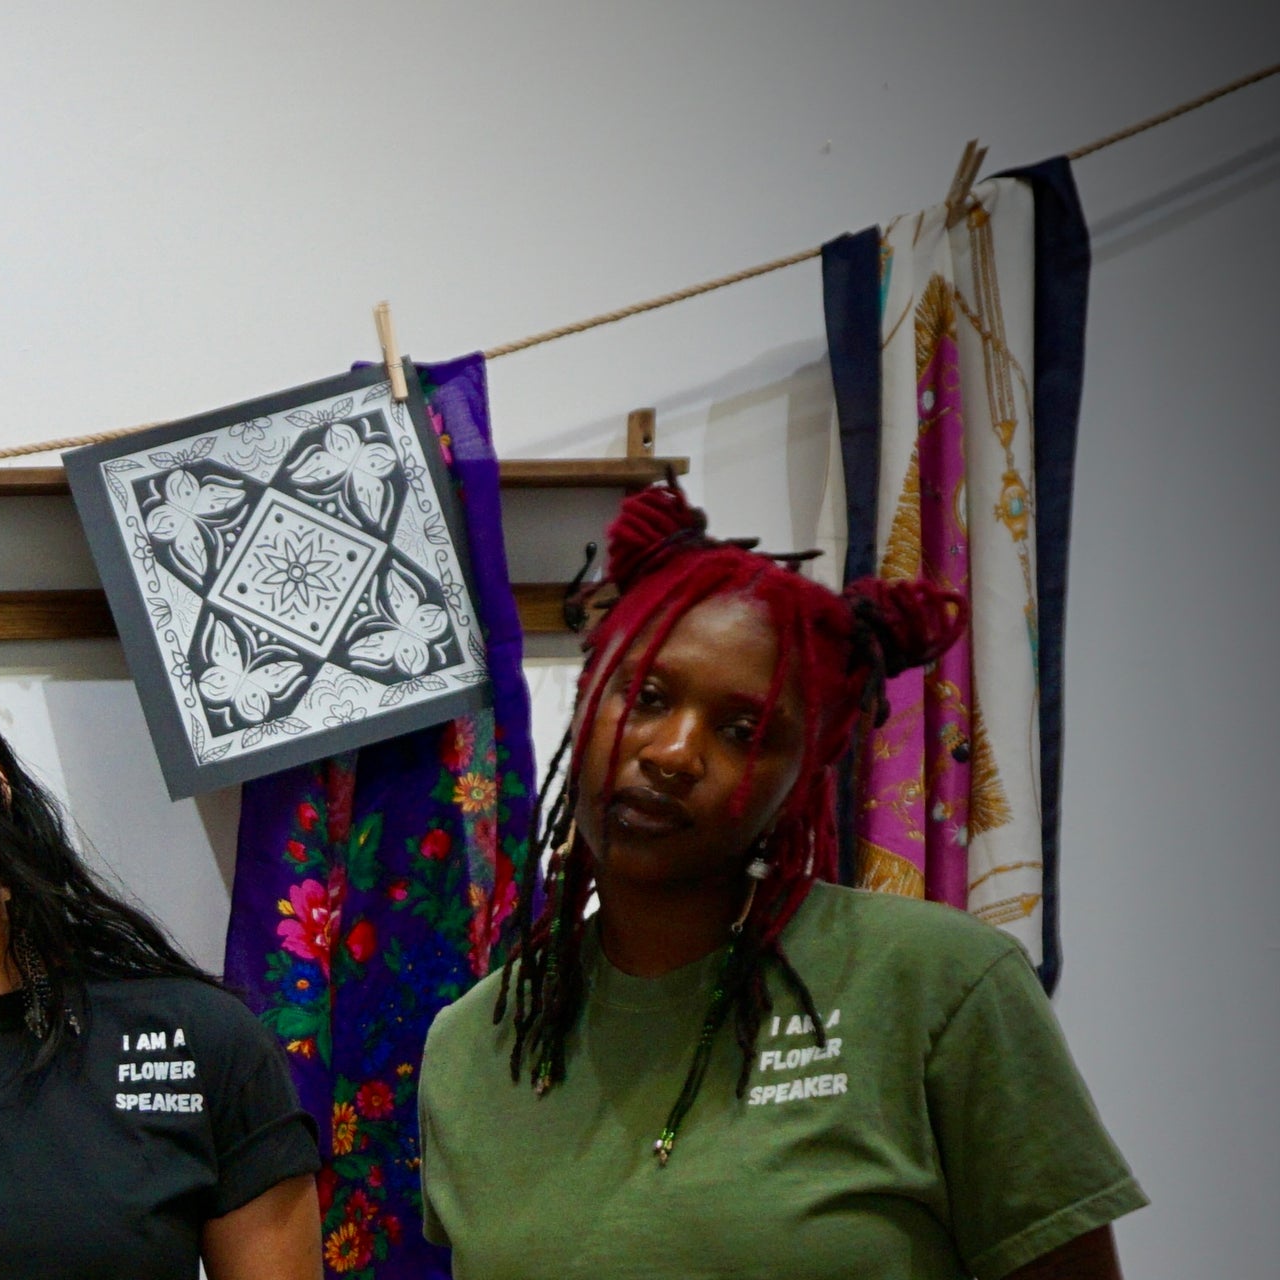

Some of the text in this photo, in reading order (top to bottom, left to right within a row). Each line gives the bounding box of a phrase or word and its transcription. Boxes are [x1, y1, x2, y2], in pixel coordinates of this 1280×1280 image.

[771, 1016, 781, 1036] I
[825, 1008, 840, 1028] A
[122, 1028, 186, 1051] I AM A
[118, 1060, 196, 1082] FLOWER
[748, 1072, 848, 1105] SPEAKER
[115, 1092, 204, 1113] SPEAKER
